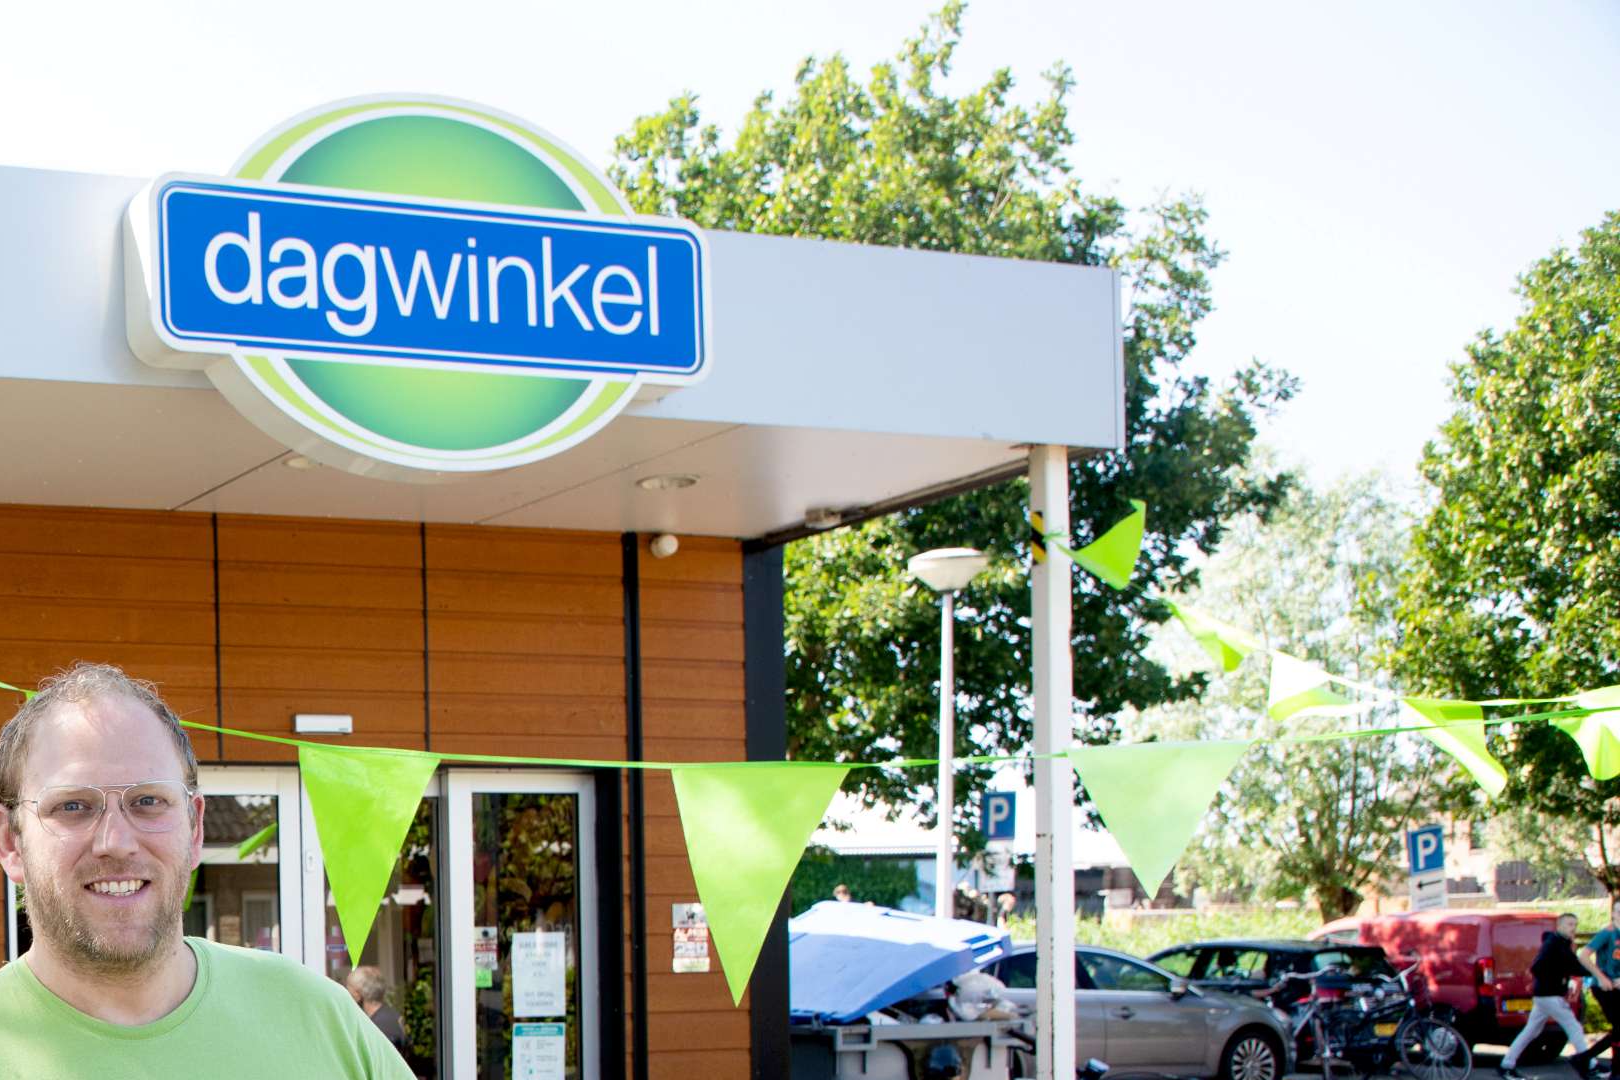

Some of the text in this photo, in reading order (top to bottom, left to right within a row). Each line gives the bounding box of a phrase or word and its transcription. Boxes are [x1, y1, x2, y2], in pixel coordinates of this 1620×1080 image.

[204, 210, 660, 337] dagwinkel
[988, 797, 1009, 836] P
[1418, 832, 1437, 869] P
